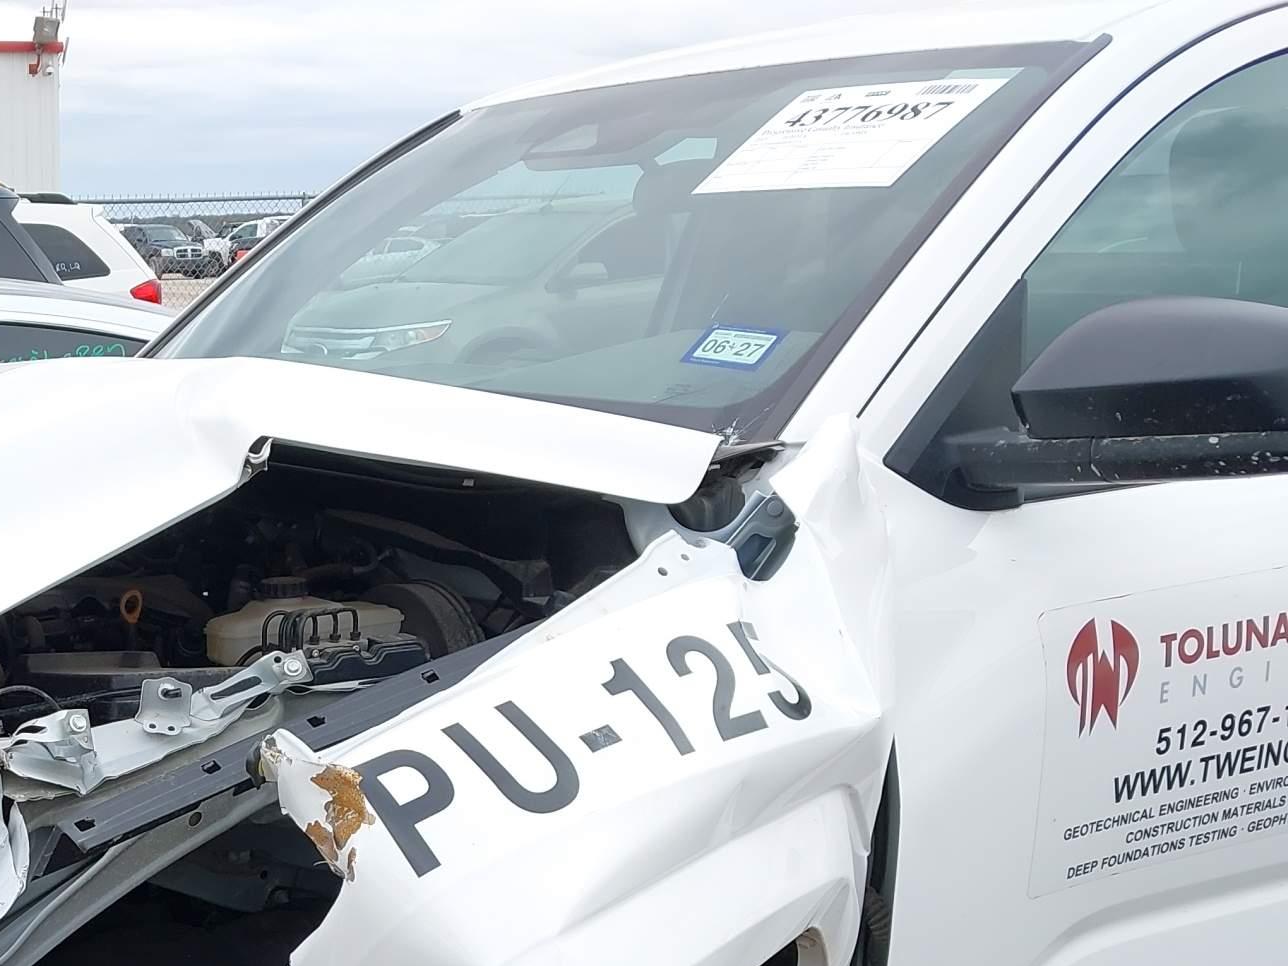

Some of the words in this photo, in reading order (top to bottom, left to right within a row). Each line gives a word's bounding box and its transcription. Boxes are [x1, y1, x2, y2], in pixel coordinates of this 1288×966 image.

[784, 101, 955, 127] 43776987
[1160, 611, 1288, 668] TOLUNA
[1159, 660, 1270, 704] ENGI
[351, 620, 813, 879] PU-125
[1063, 807, 1155, 841] GEOTECHNICAL
[1158, 787, 1239, 817] ENGINEERING
[1125, 811, 1219, 844] CONSTRUCTION
[1221, 795, 1287, 822] MATERIALS
[1066, 860, 1099, 880] DEEP
[1100, 837, 1186, 870] FOUNDATIONS
[1188, 826, 1238, 848] TESTING
[1246, 812, 1288, 833] GEOPH
